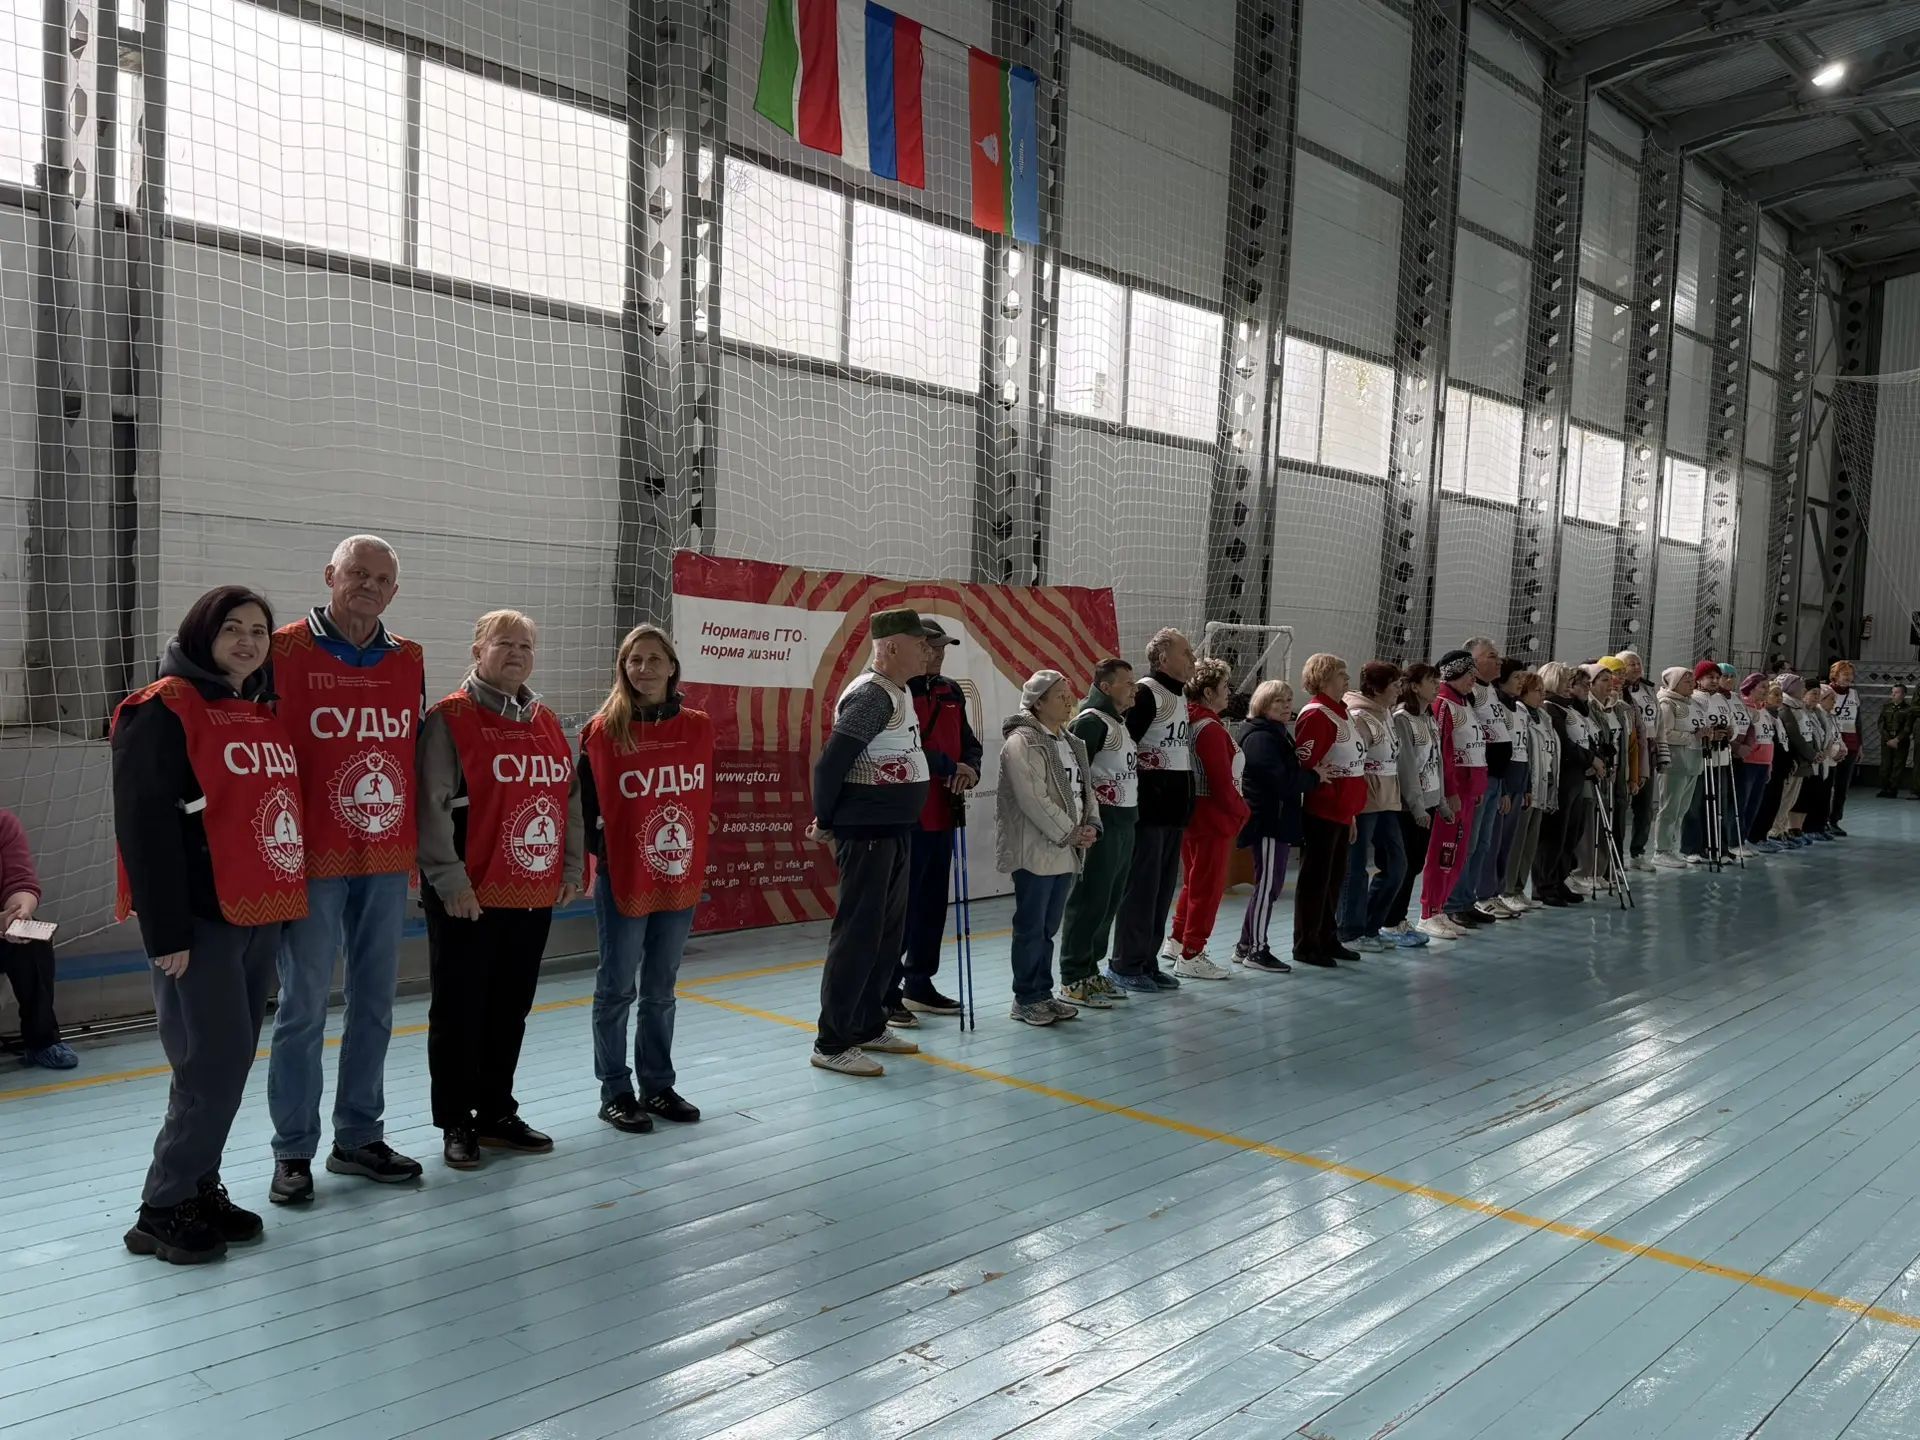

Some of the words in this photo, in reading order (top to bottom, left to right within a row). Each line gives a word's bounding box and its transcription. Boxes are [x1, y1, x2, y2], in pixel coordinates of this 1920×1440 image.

[701, 621, 770, 641] Норматив
[700, 644, 745, 660] норма
[1834, 706, 1851, 717] 93
[310, 706, 411, 742] СУДЬЯ
[1708, 714, 1728, 727] 98
[619, 763, 705, 798] СУДЬЯ
[715, 770, 781, 785] www.gto.ru
[366, 804, 385, 814] ГТО
